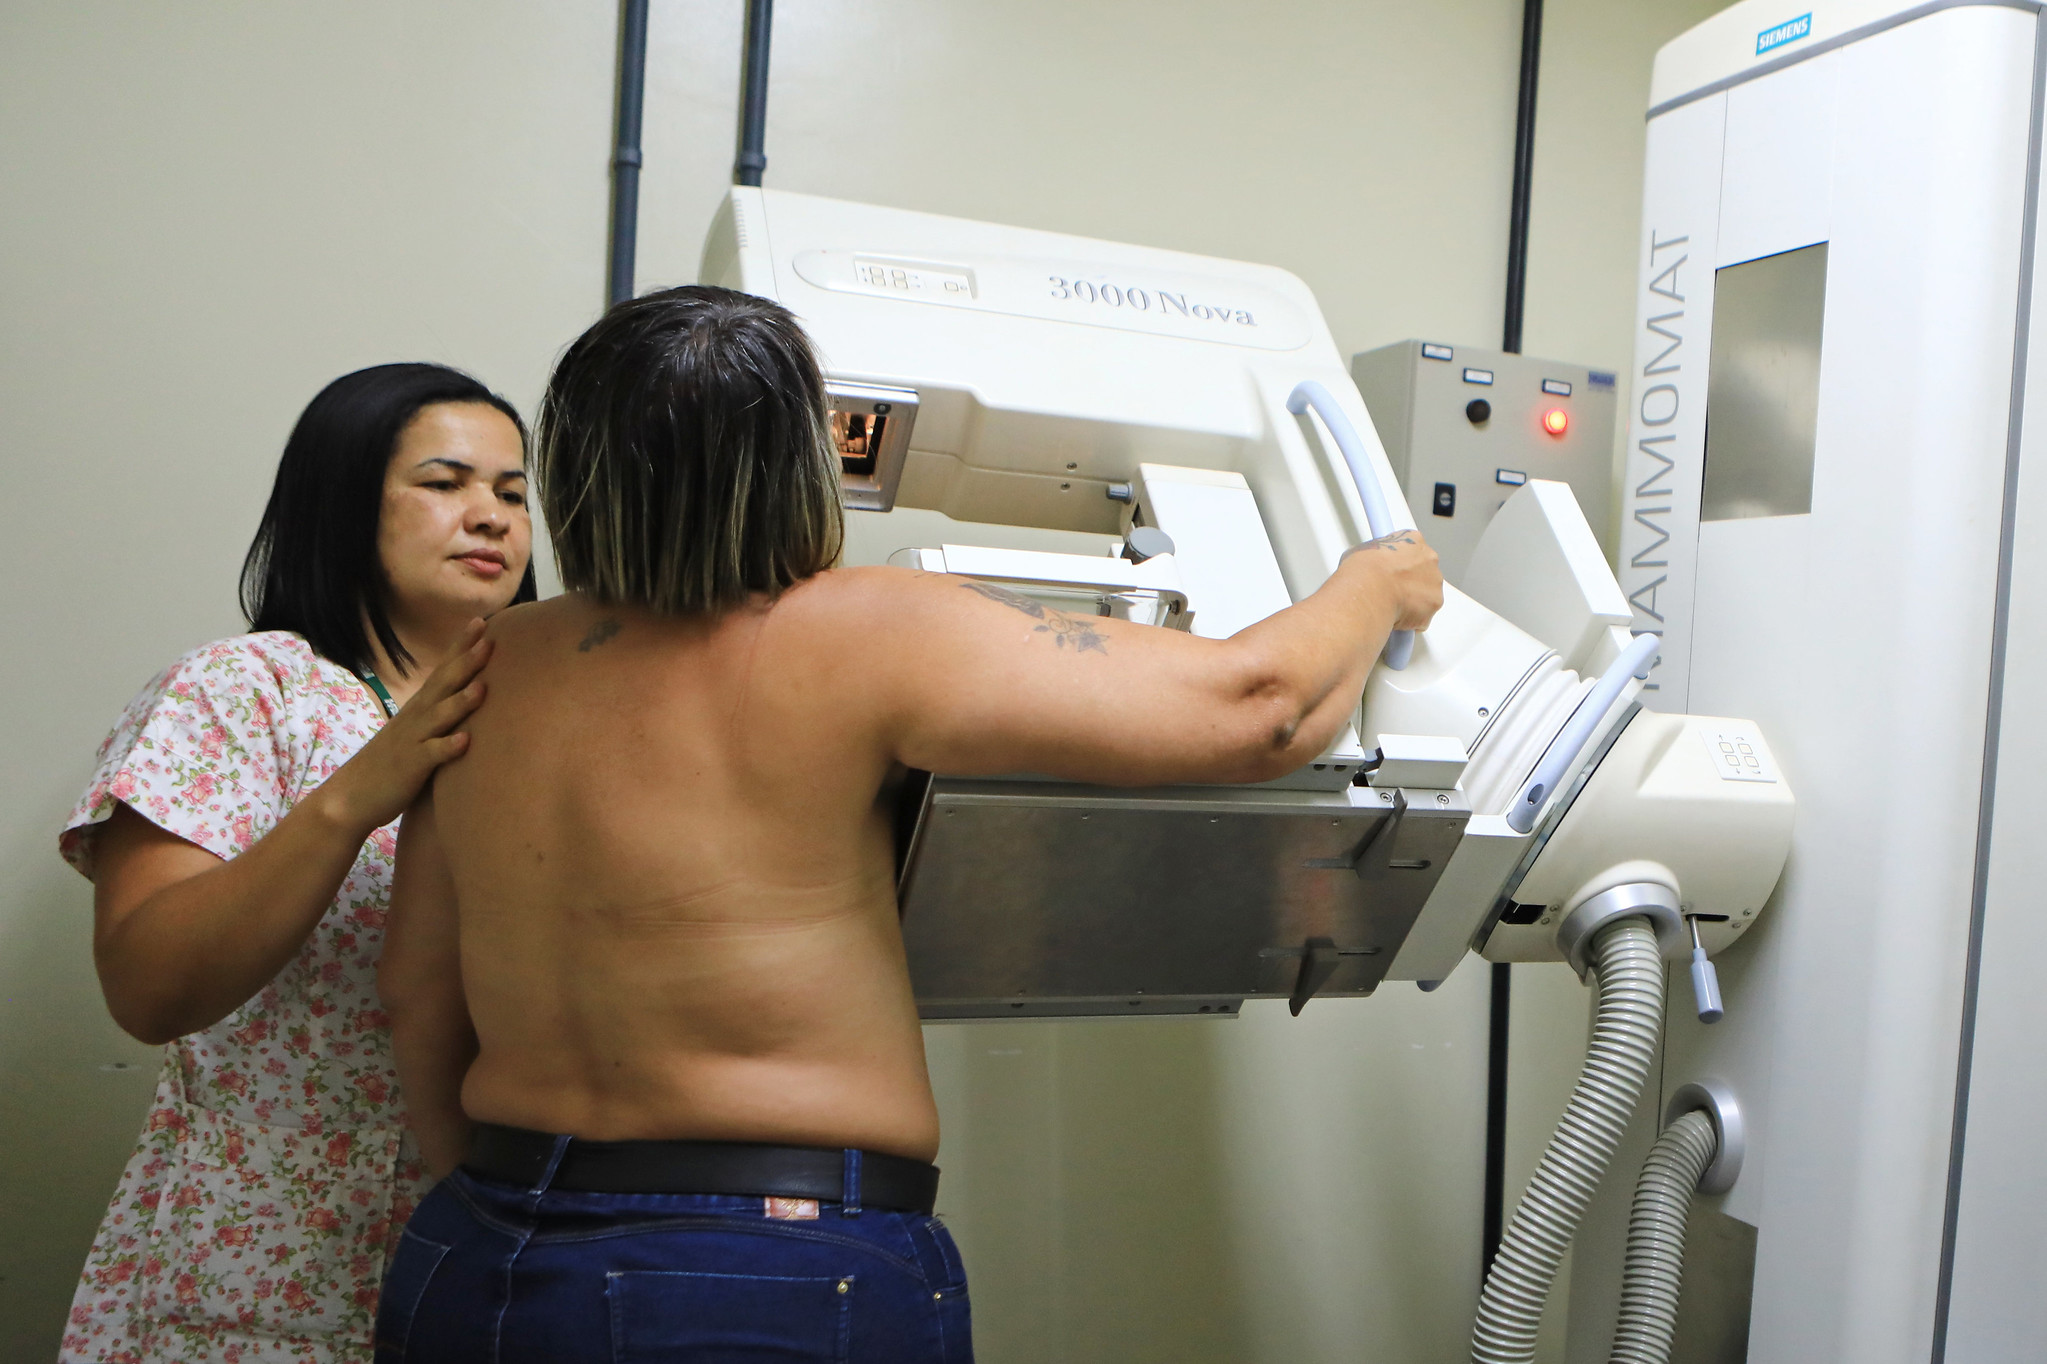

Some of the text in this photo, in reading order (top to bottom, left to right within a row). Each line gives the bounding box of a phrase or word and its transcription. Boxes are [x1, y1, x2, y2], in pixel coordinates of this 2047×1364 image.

[1759, 17, 1809, 51] SIEMENS
[1049, 276, 1258, 327] 3000 Nova
